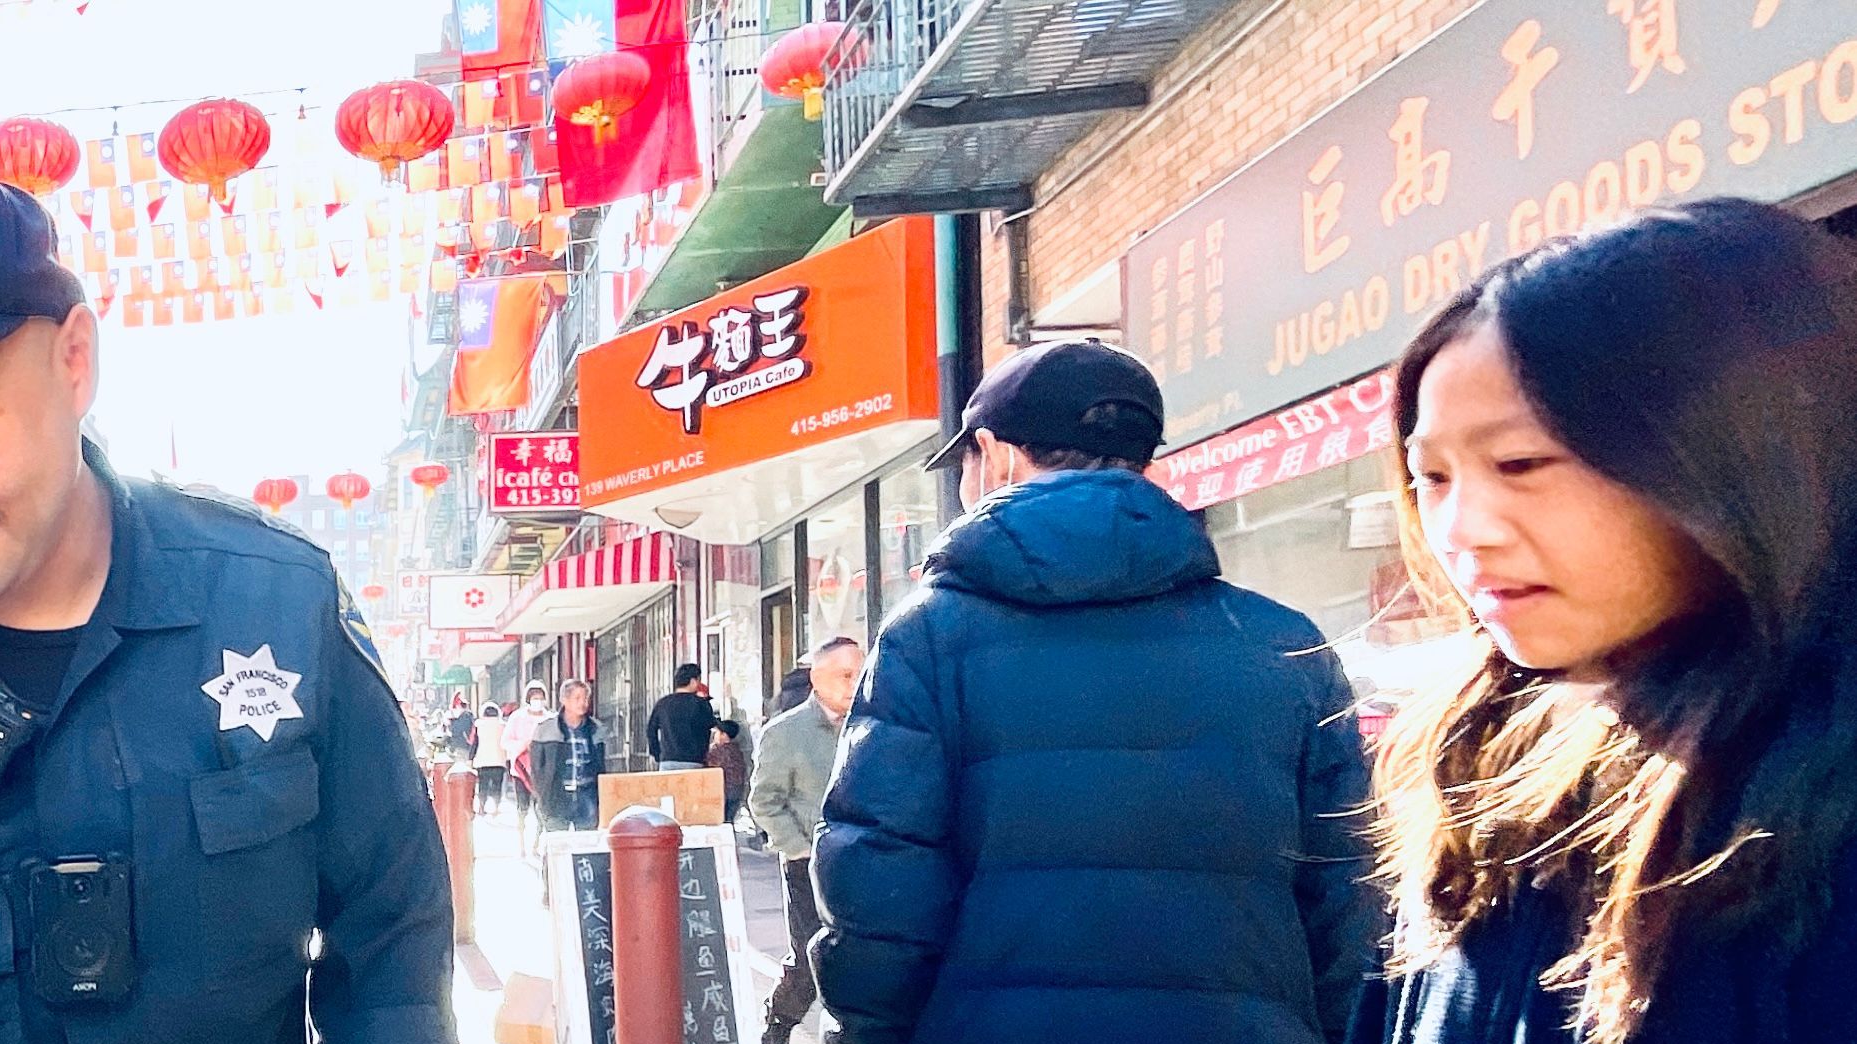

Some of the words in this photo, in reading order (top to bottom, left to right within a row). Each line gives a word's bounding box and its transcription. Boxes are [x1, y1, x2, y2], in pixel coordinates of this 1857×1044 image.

[1301, 0, 1783, 274] 巨高干貨
[1267, 276, 1389, 376] JUGAO
[1402, 221, 1491, 314] DRY
[1507, 118, 1703, 253] GOODS
[712, 378, 762, 402] UTOPIA
[790, 393, 893, 436] 415-956-2902
[1167, 428, 1277, 481] Welcome
[1276, 393, 1342, 440] EBT
[584, 482, 603, 497] 139
[605, 465, 661, 491] WAVERLY
[663, 451, 704, 475] PLACE
[219, 679, 235, 697] SAN
[236, 669, 288, 689] FRANCISCO
[239, 700, 281, 716] POLICE
